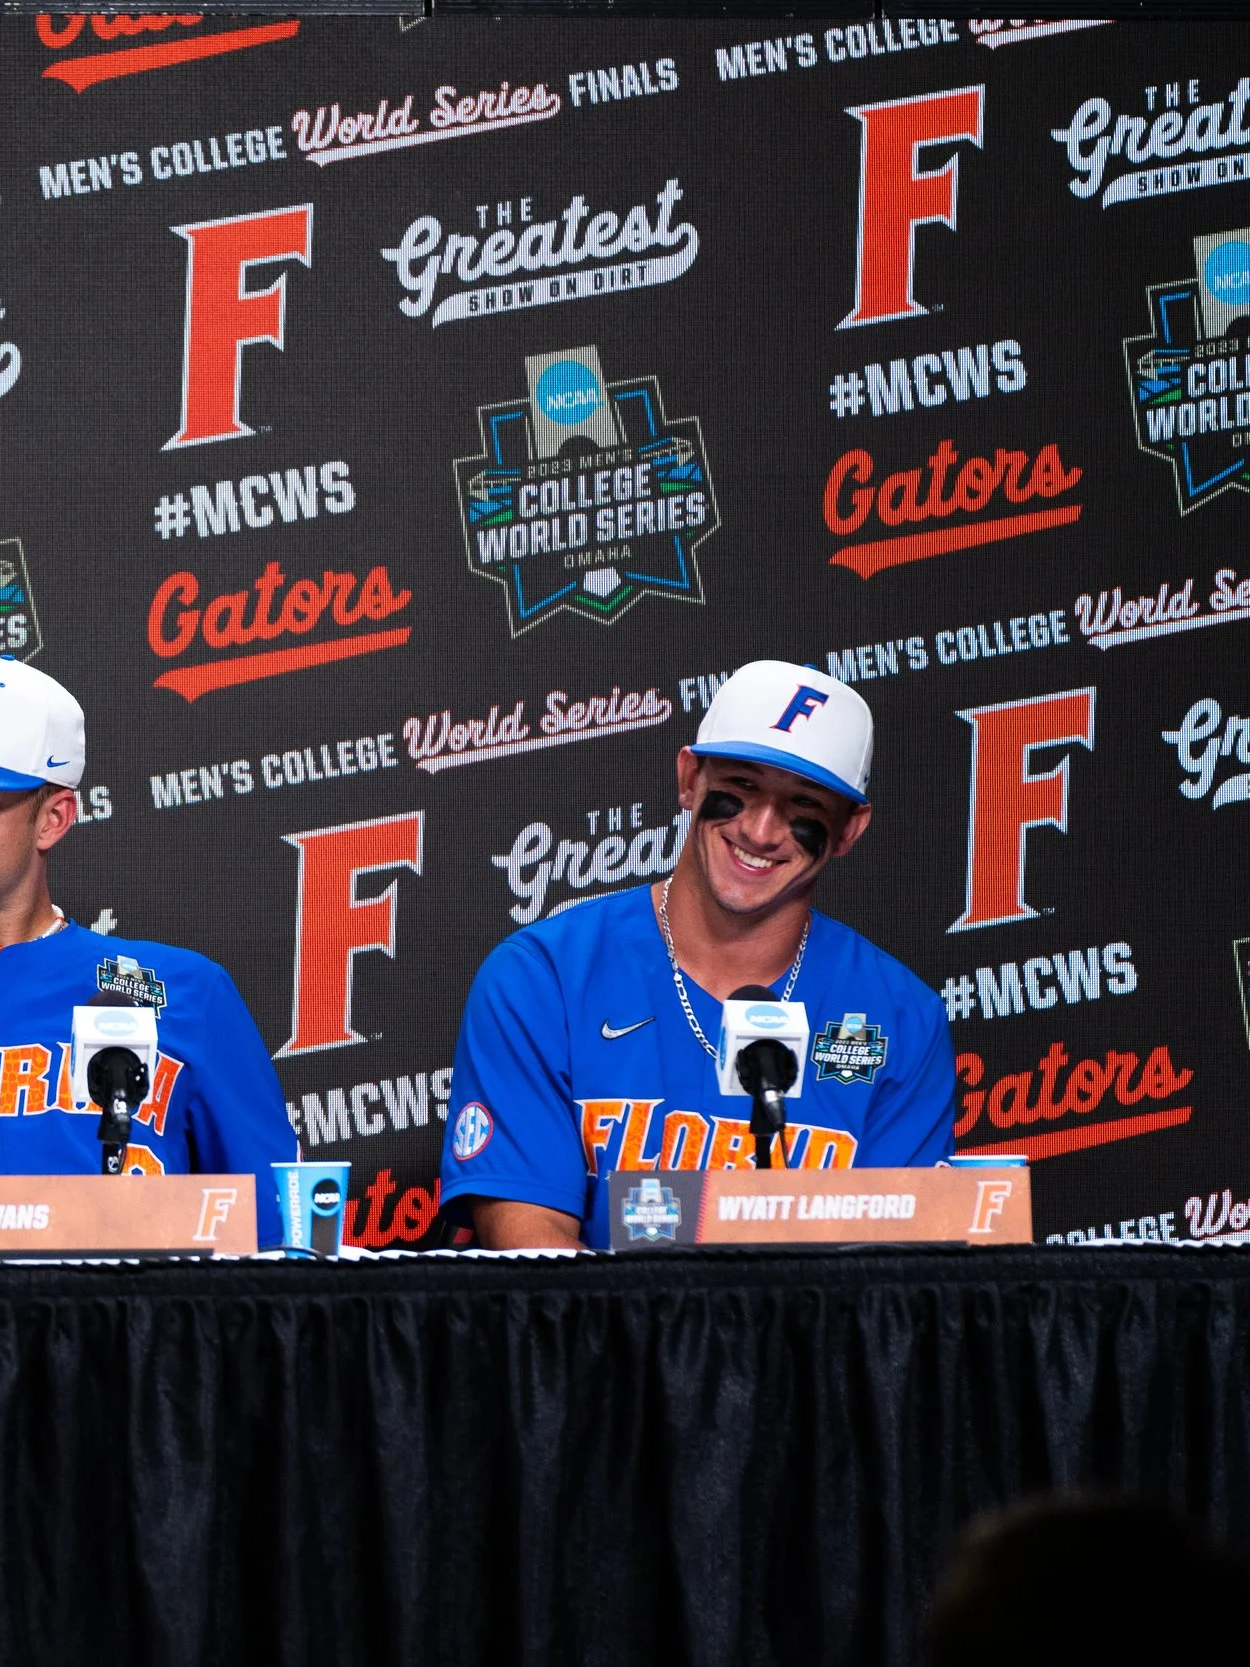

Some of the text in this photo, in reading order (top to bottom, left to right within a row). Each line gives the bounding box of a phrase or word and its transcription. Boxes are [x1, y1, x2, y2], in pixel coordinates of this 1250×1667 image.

[716, 19, 960, 82] MEN'S COLLEGE
[1145, 79, 1200, 111] THE
[39, 57, 680, 200] MEN'S COLLEGE World Series FINALS
[1138, 158, 1244, 194] SHOW ON
[476, 197, 533, 228] THE
[834, 84, 986, 331] F
[380, 177, 685, 317] Greatest
[468, 264, 648, 312] SHOW ON DIRT
[160, 202, 314, 452] F
[545, 387, 601, 411] NCAA
[830, 339, 1028, 418] #MCWS
[579, 448, 634, 471] MEN'S
[154, 460, 357, 540] #MCWS
[518, 463, 651, 517] COLLEGE
[824, 439, 1083, 536] Gators
[477, 491, 707, 564] WORLD SERIES
[564, 544, 632, 568] OMAHA
[148, 561, 413, 658] Gators
[826, 636, 929, 684] MEN'S
[936, 609, 1070, 664] COLLEGE
[1074, 577, 1200, 636] World
[769, 683, 829, 731] F
[150, 757, 252, 809] MEN'S
[260, 733, 398, 789] COLLEGE
[403, 698, 530, 758] World
[540, 685, 672, 734] Series
[586, 803, 643, 835] THE
[954, 686, 1097, 934] F
[271, 812, 426, 1059] F
[101, 981, 132, 995] WORLD
[133, 990, 163, 1004] SERIES
[113, 977, 150, 993] COLLEGE
[941, 941, 1138, 1021] #MCWS
[814, 1052, 883, 1065] WORLD SERIES
[830, 1044, 871, 1056] COLLEGE
[453, 1106, 492, 1159] SEC
[193, 1188, 237, 1241] F
[286, 1170, 303, 1248] POWERADE
[718, 1194, 917, 1221] WYATT LANGFORD
[967, 1181, 1012, 1233] F
